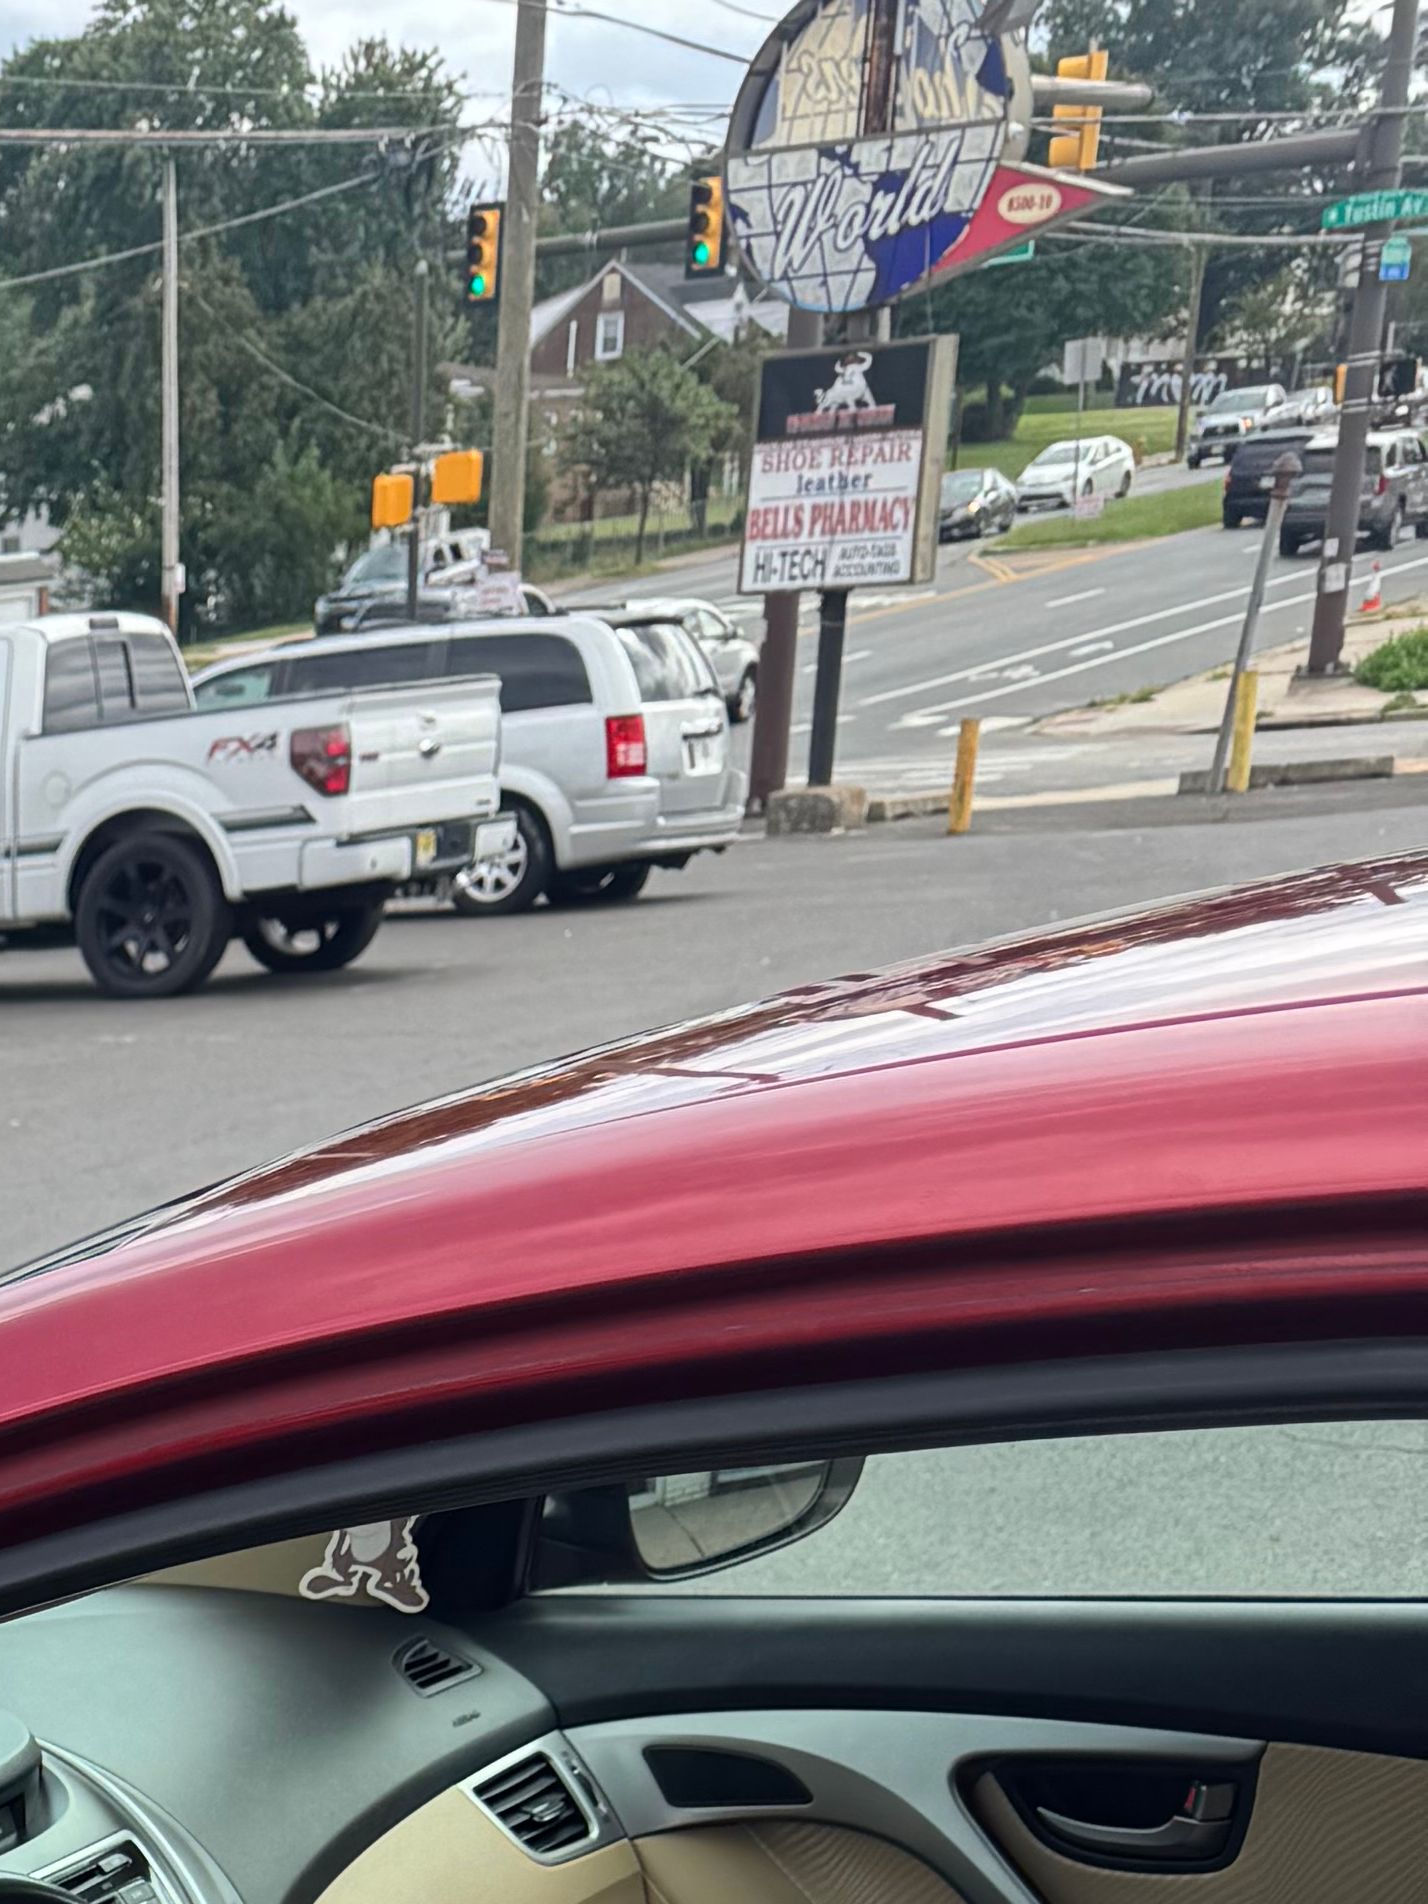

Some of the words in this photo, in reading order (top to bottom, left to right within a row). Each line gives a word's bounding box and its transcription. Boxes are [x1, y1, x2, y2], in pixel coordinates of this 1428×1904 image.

[774, 135, 963, 280] World
[761, 450, 822, 473] SHOE
[830, 441, 912, 468] REPAIR
[748, 504, 804, 541] BELLS
[809, 497, 910, 538] PHARMACY
[752, 549, 827, 583] HI-TECH
[207, 731, 279, 763] FX4
